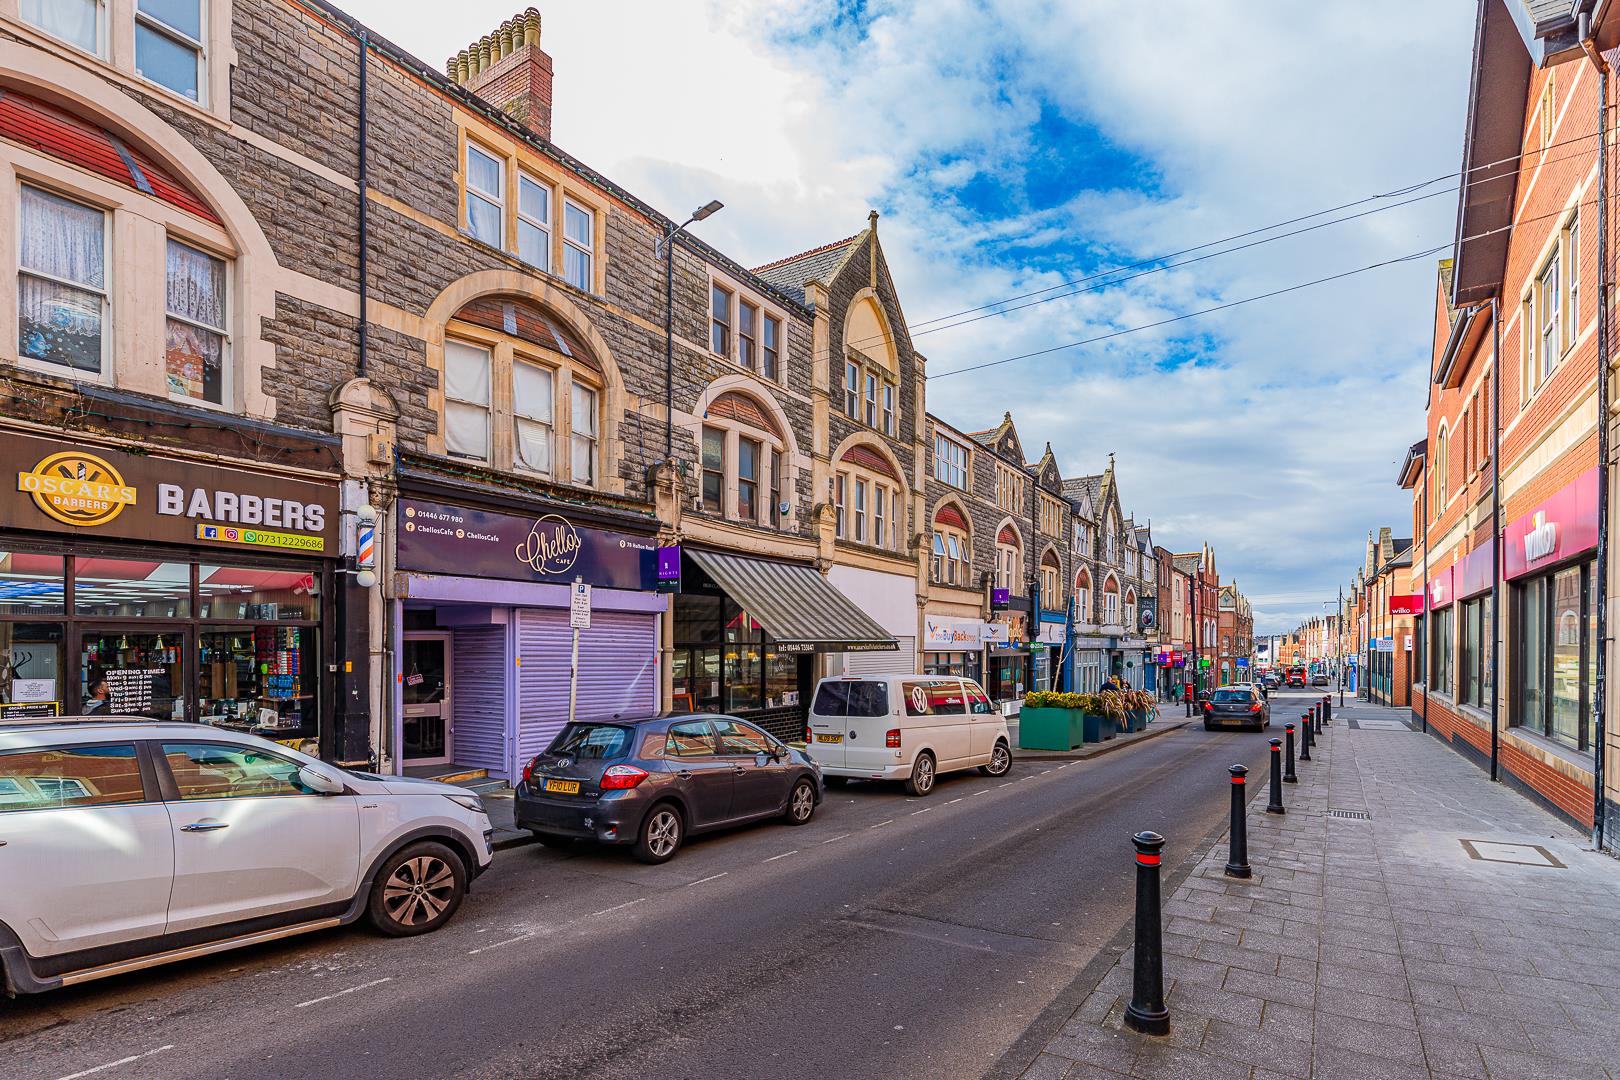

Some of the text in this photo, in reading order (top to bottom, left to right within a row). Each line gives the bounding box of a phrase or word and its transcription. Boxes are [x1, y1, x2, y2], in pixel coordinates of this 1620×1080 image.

[24, 476, 133, 502] OSCAR'S
[54, 496, 108, 510] BARBERS
[158, 484, 324, 532] BARBERS
[418, 510, 438, 520] 01446
[418, 526, 453, 536] ChellosCafe
[467, 532, 499, 542] ChellosCafe
[258, 534, 323, 549] 07312229686
[516, 526, 582, 574] Chellos
[563, 782, 577, 792] LUR
